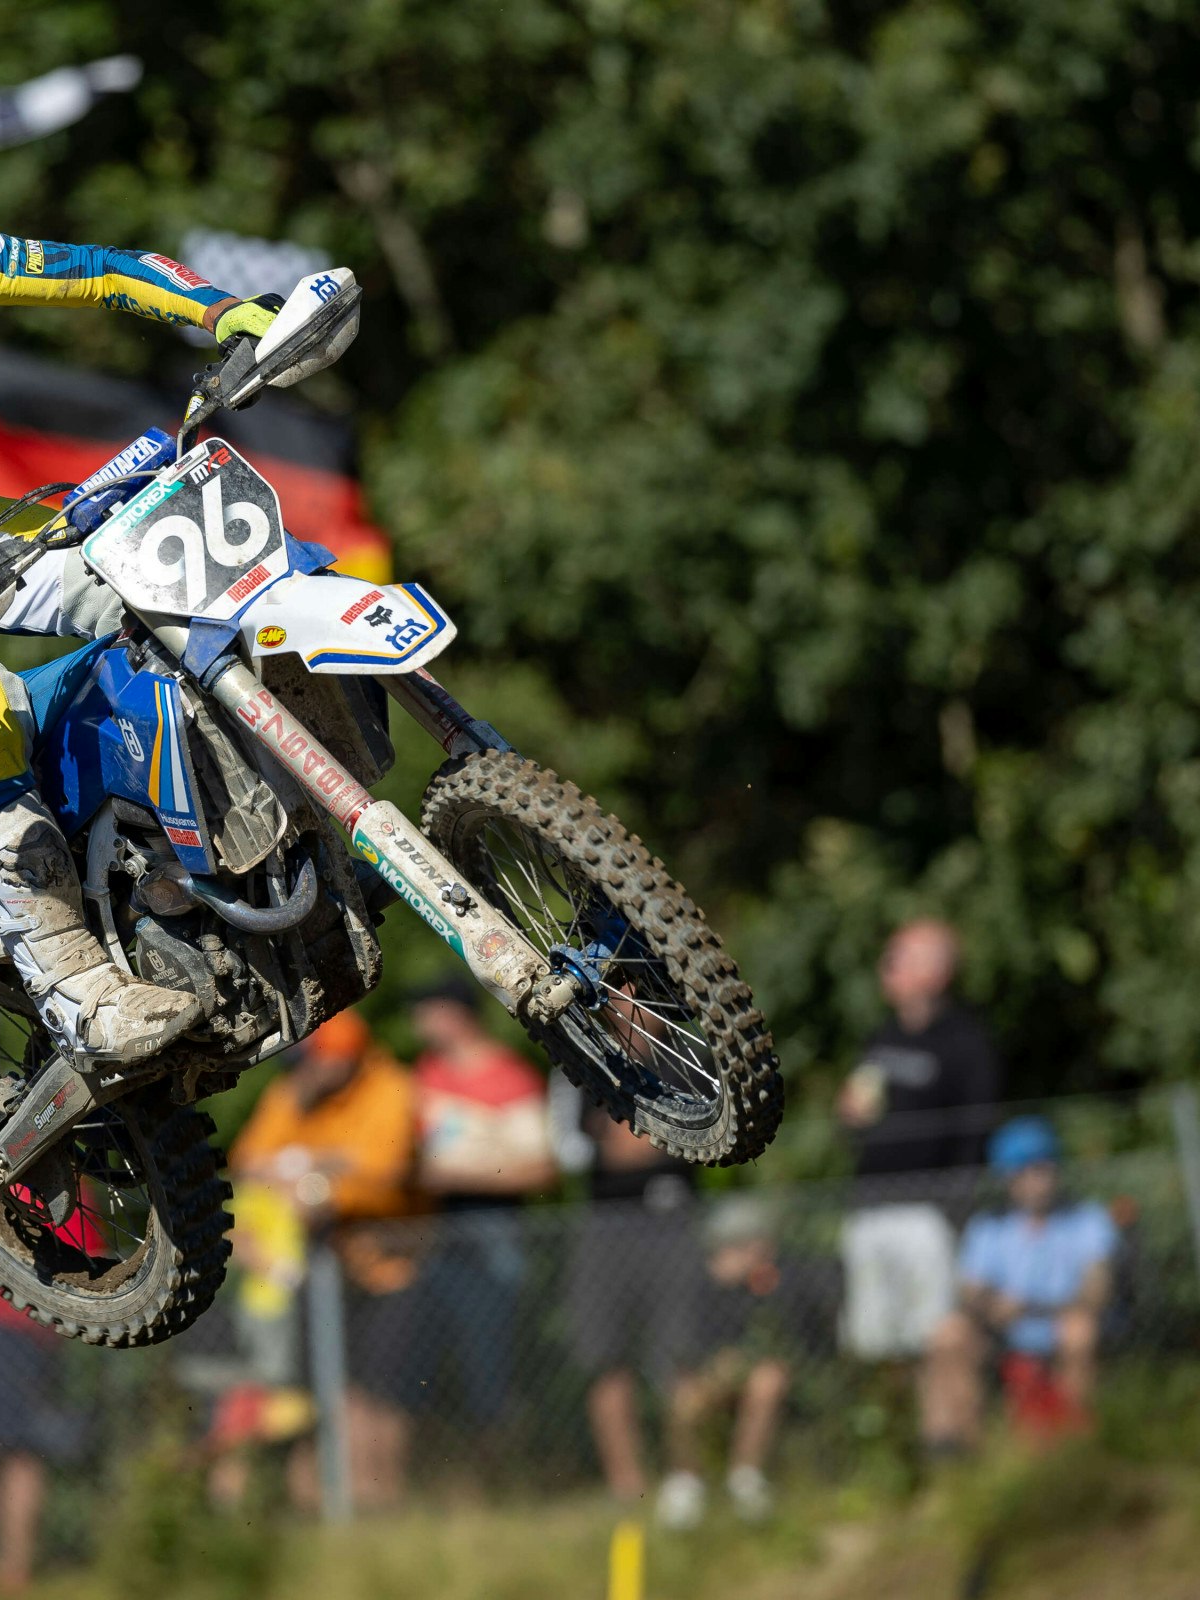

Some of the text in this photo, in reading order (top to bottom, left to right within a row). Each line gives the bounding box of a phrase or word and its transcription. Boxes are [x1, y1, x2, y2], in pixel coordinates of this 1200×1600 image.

[102, 481, 172, 547] OTOREX
[141, 474, 270, 614] 96
[226, 564, 272, 603] nestaan
[340, 590, 385, 625] nestaan
[257, 628, 286, 645] FMF
[237, 690, 274, 728] WP
[160, 812, 197, 827] Husqvarna
[378, 860, 455, 943] MOTOREX
[135, 1037, 162, 1053] FOX
